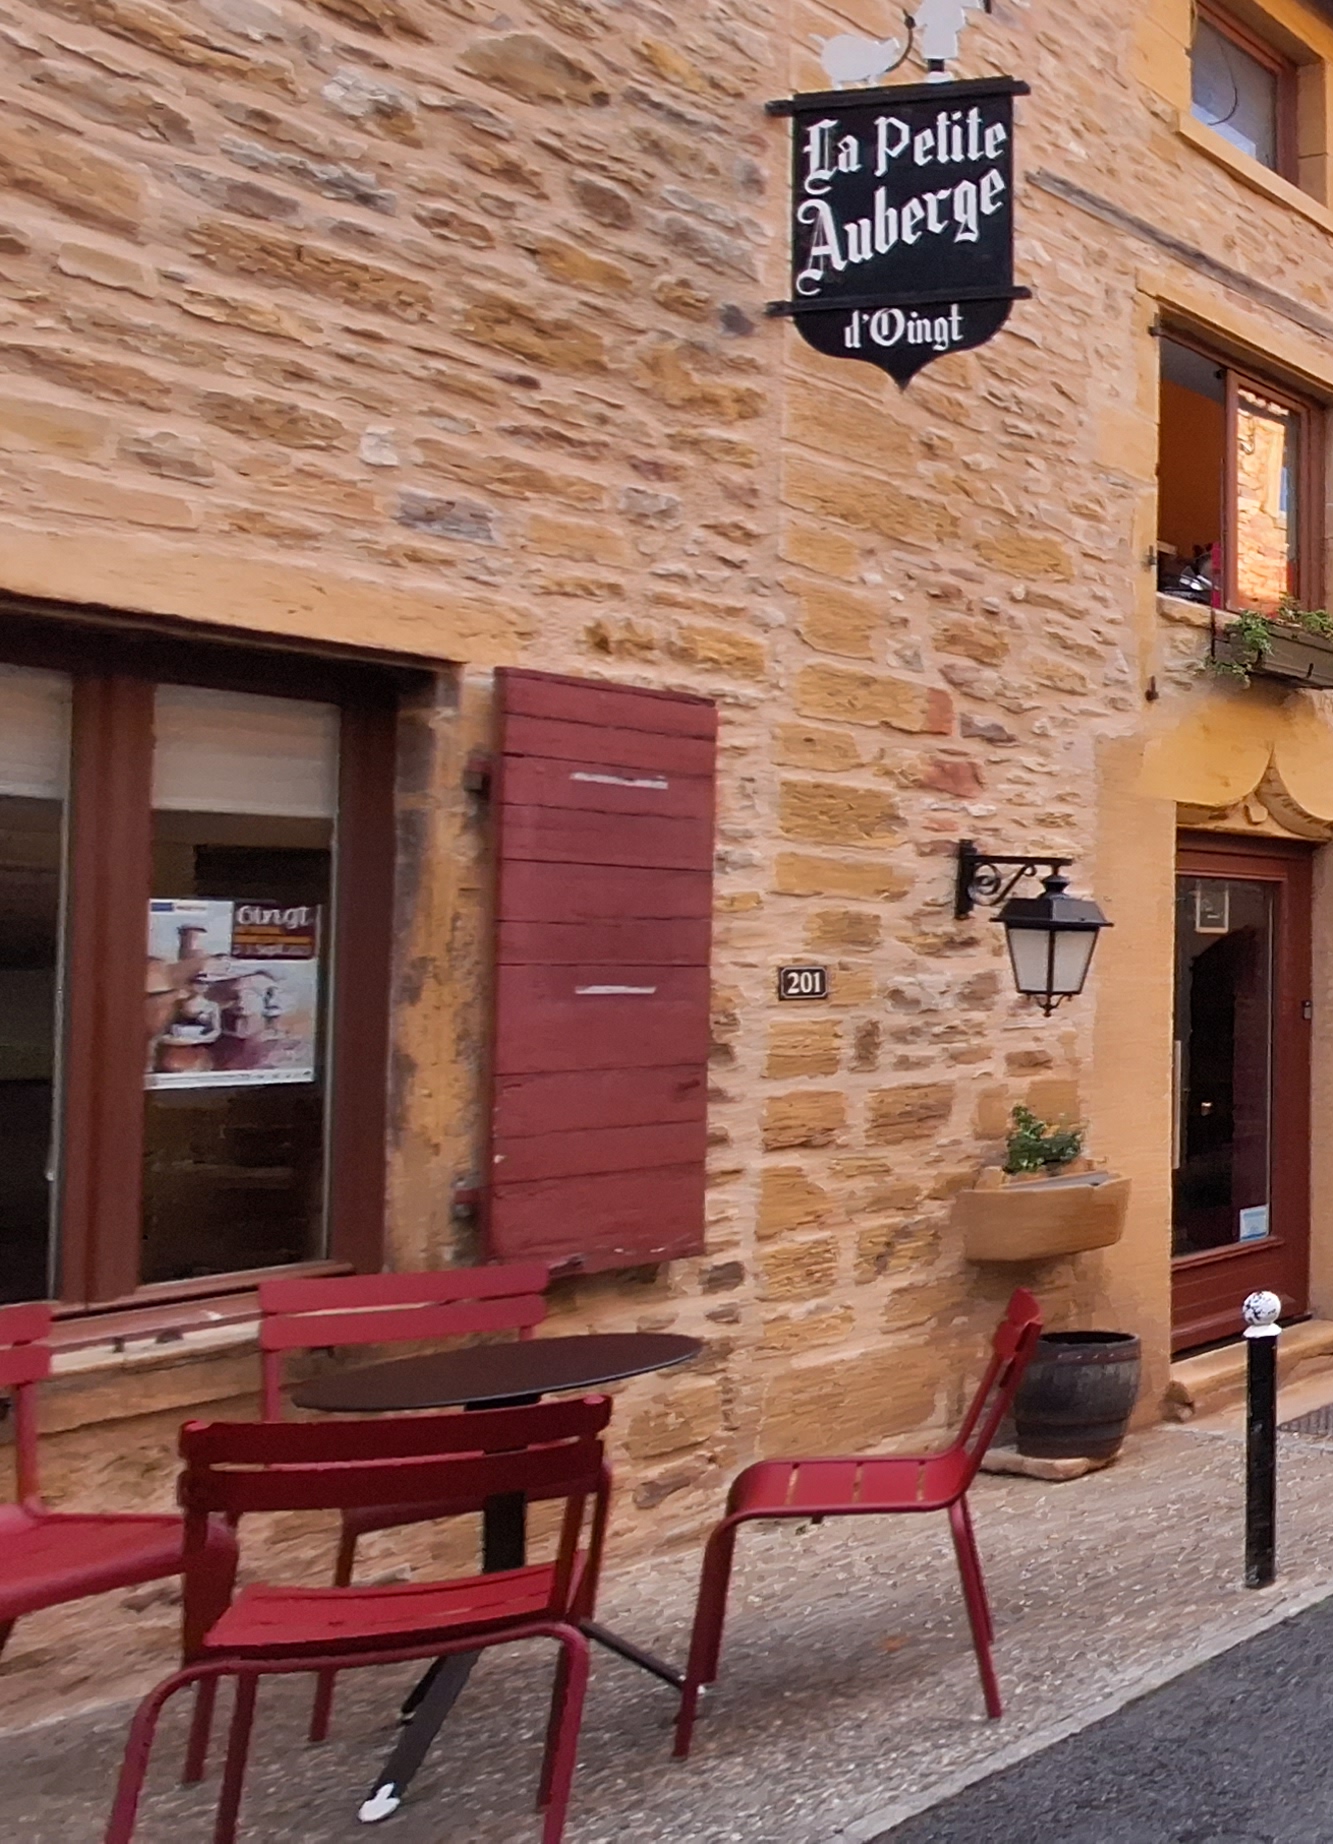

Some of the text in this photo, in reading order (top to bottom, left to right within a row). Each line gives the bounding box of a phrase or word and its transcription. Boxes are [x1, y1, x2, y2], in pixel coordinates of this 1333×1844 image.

[803, 106, 1006, 196] La Petite
[796, 168, 1006, 296] Auberge
[844, 304, 964, 351] d'Oingt
[787, 971, 821, 994] 201
